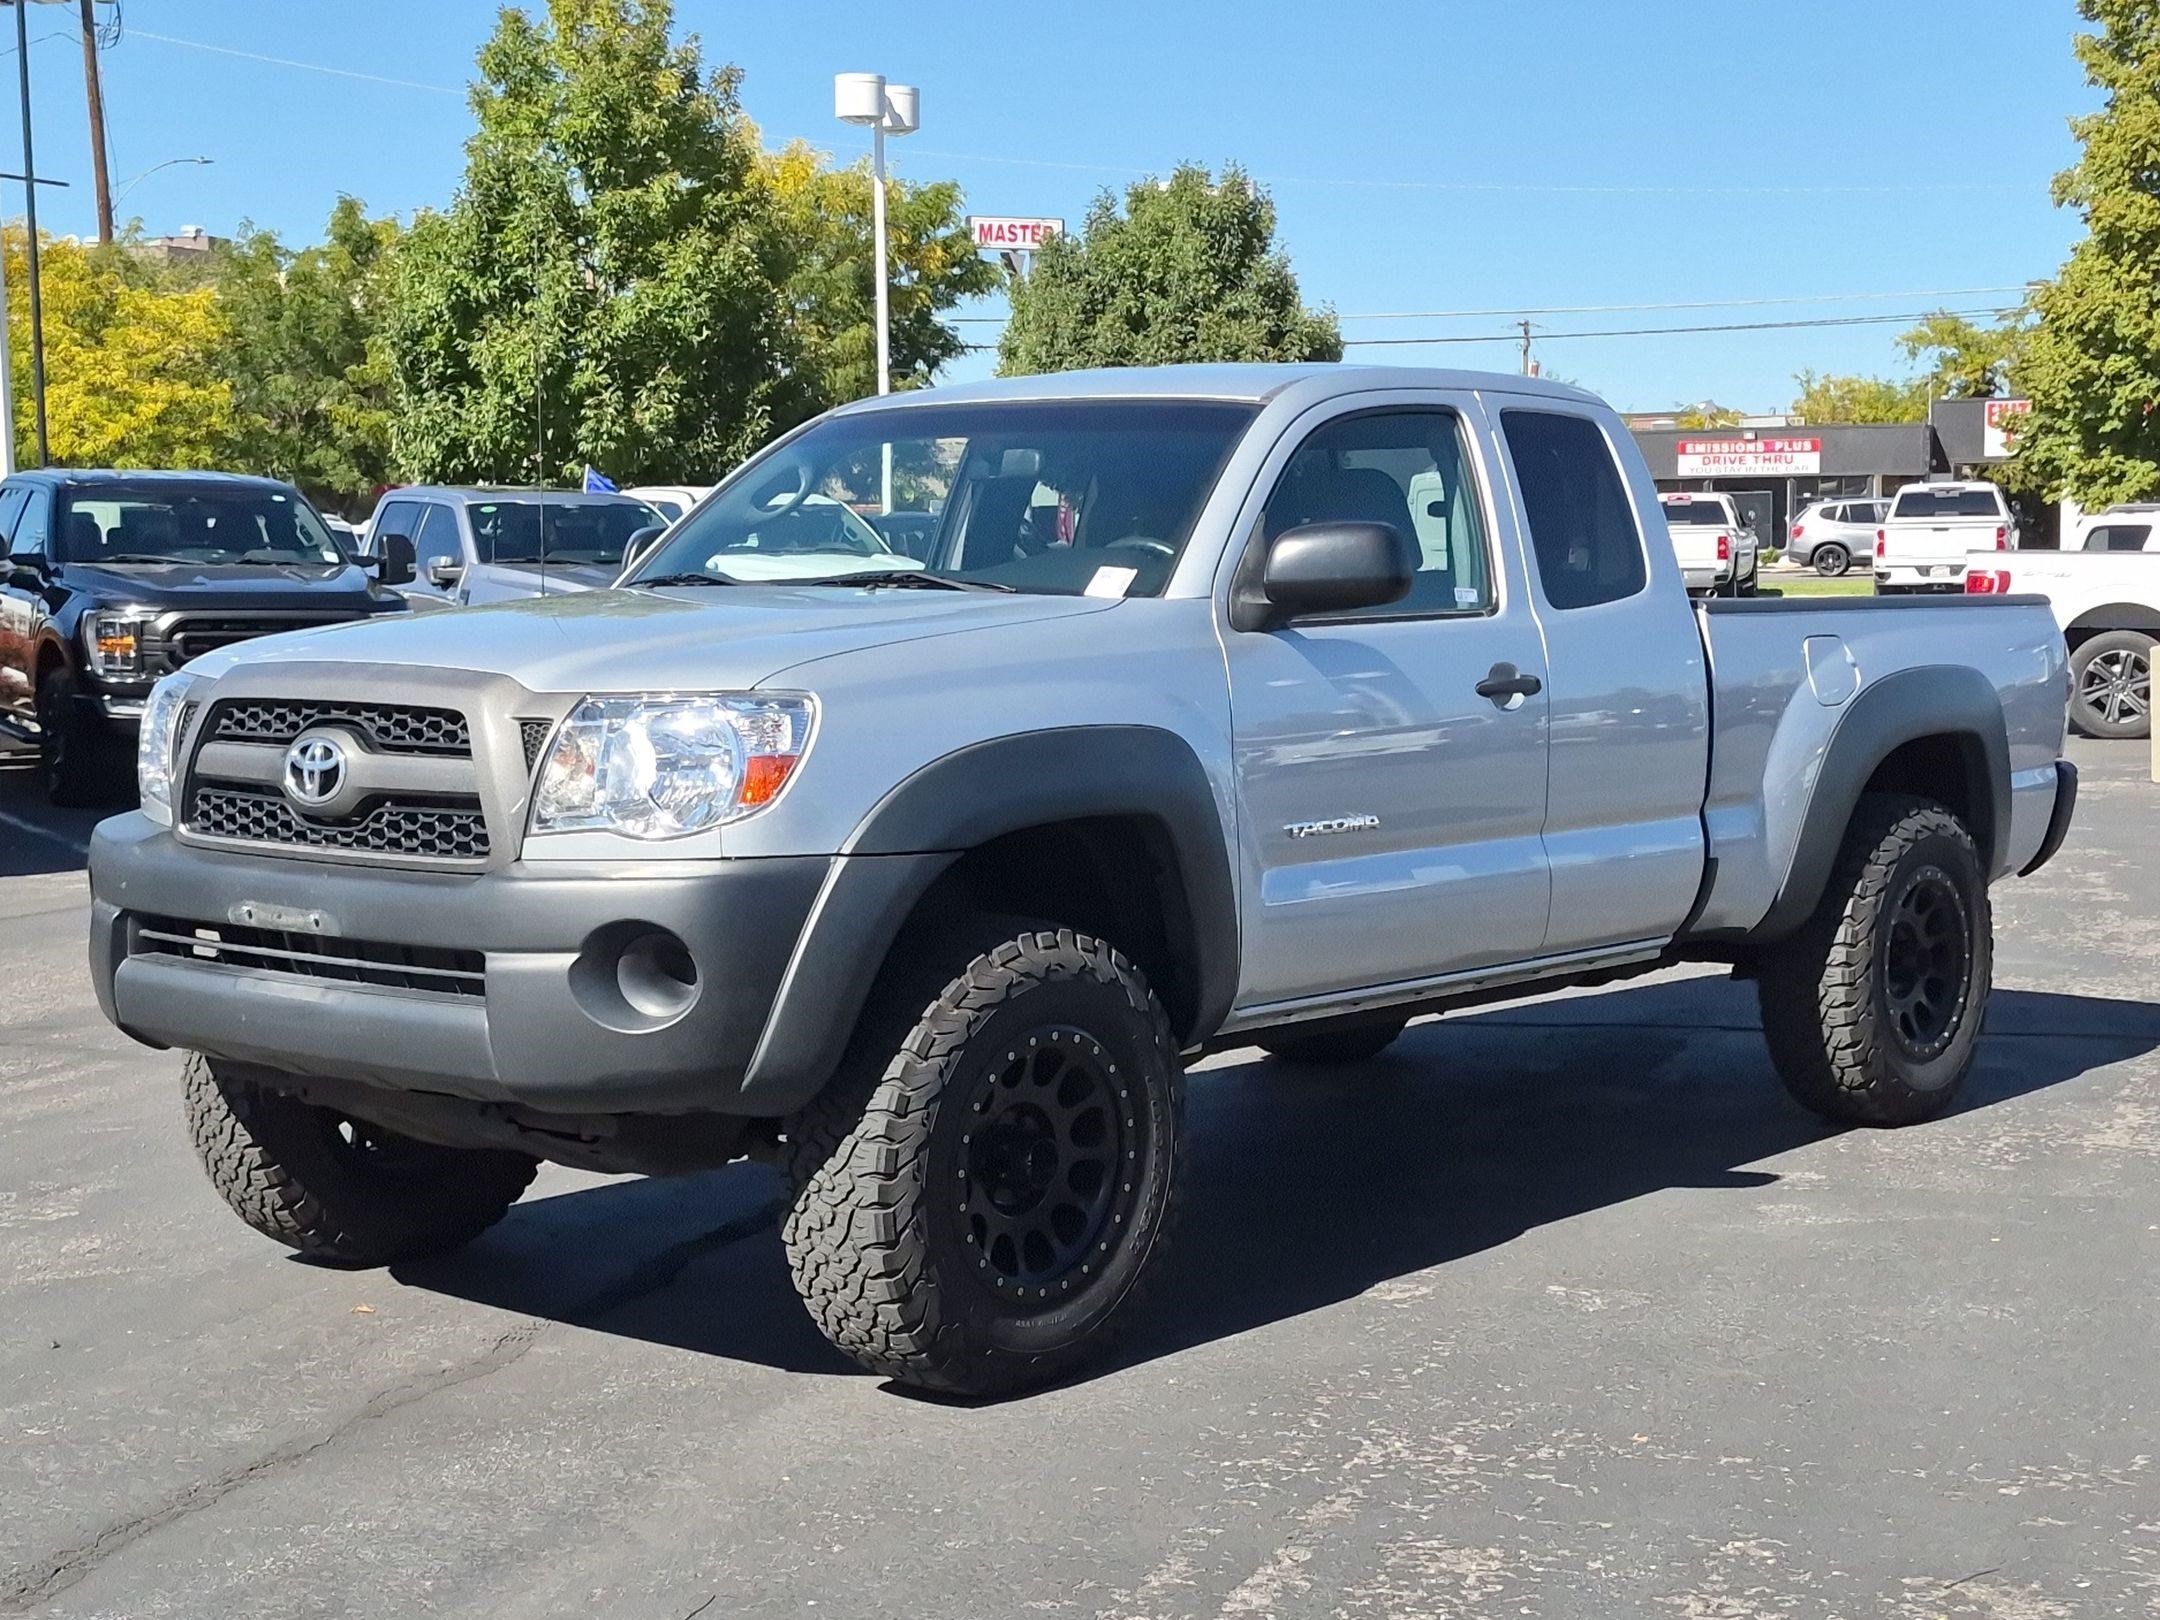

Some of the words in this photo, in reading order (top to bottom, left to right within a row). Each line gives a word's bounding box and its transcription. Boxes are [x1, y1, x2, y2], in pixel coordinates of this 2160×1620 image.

[1685, 442, 1764, 454] EMISSIONS
[1774, 440, 1811, 452] PLUS
[1702, 455, 1747, 465] DRIVE
[1753, 454, 1794, 464] THRU
[1283, 814, 1380, 838] TACOMA
